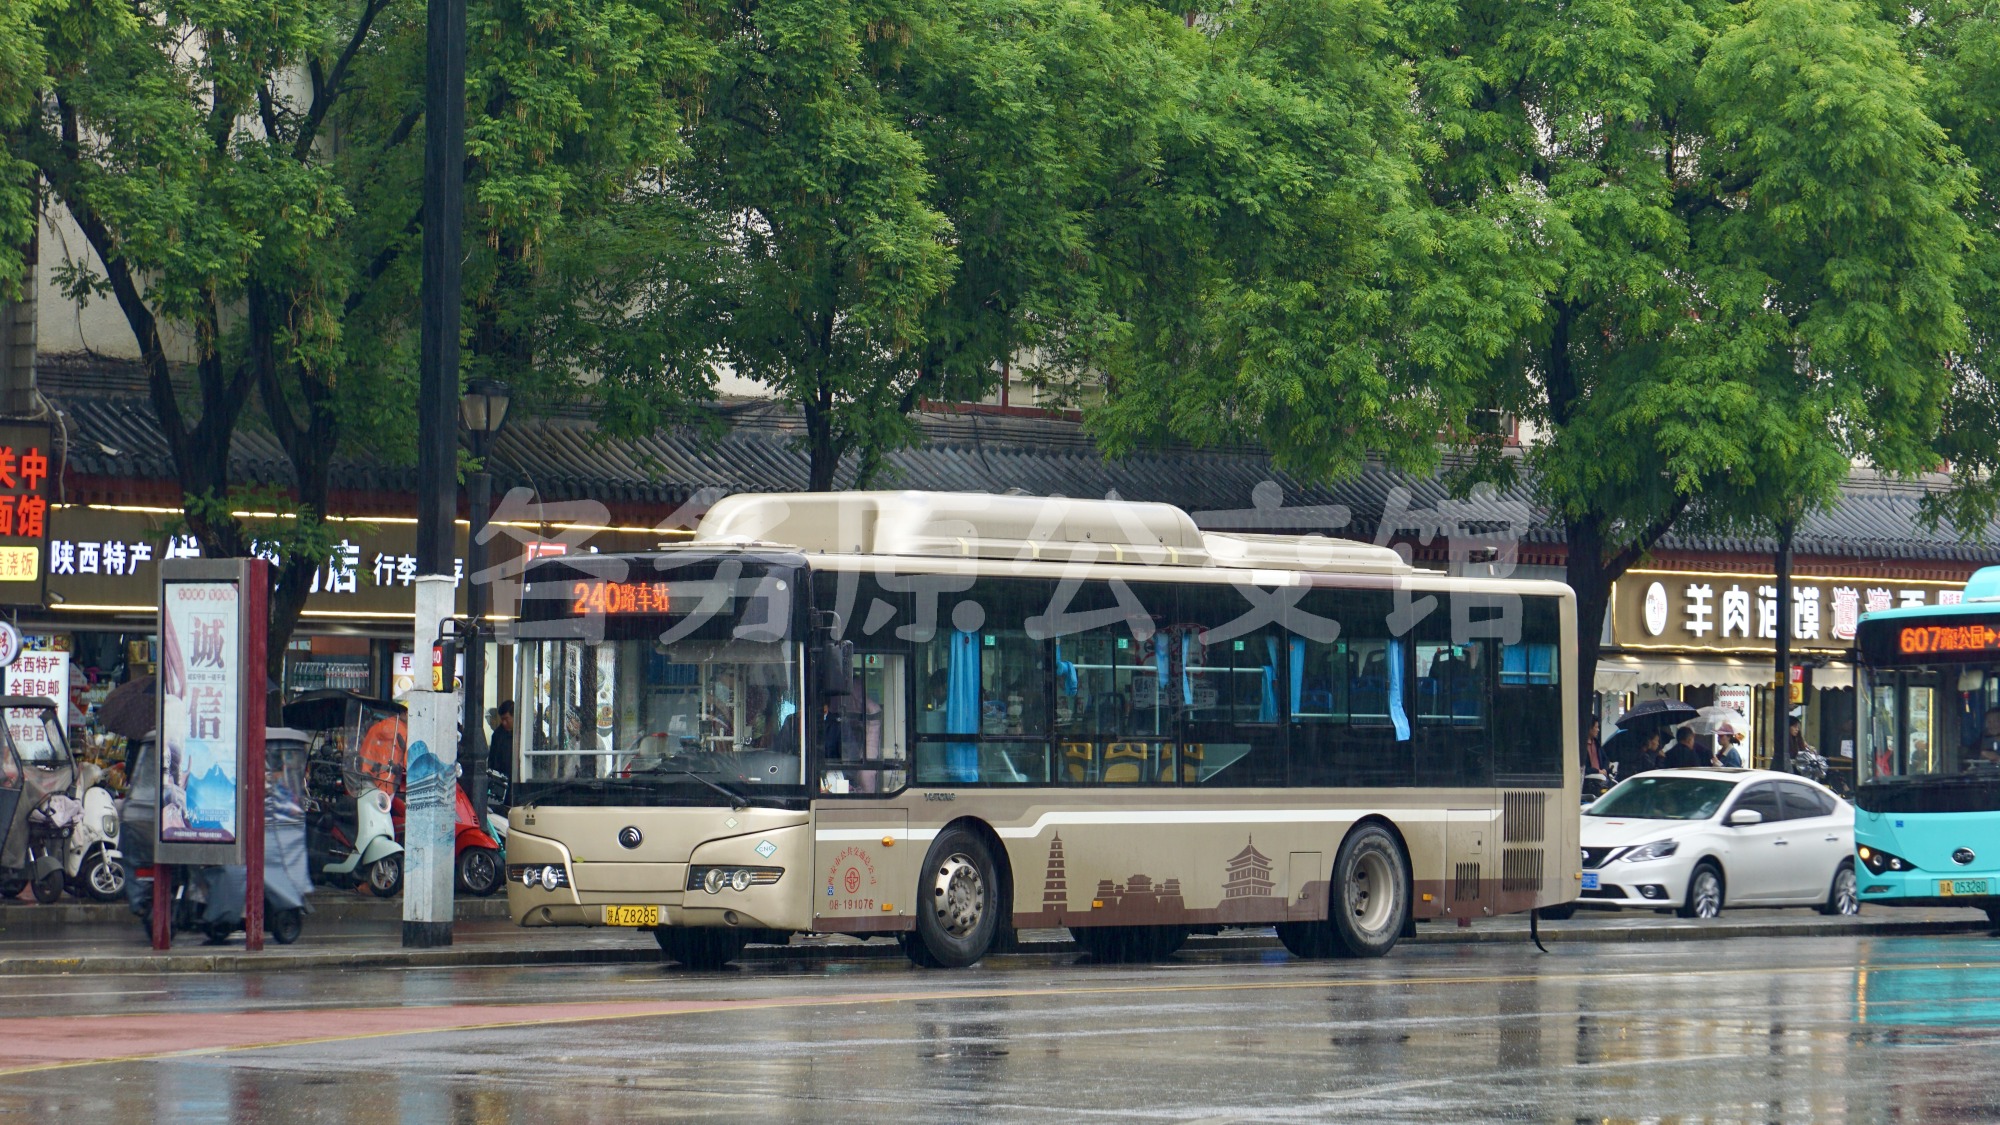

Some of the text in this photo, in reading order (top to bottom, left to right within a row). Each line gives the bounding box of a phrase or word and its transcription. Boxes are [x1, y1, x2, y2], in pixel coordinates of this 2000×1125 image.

[0, 552, 33, 576] 浇饭
[51, 540, 151, 575] 陕西特产
[374, 552, 463, 588] 行李
[11, 656, 60, 673] 陕西特产
[11, 679, 60, 697] 全国包邮
[189, 686, 222, 739] 信
